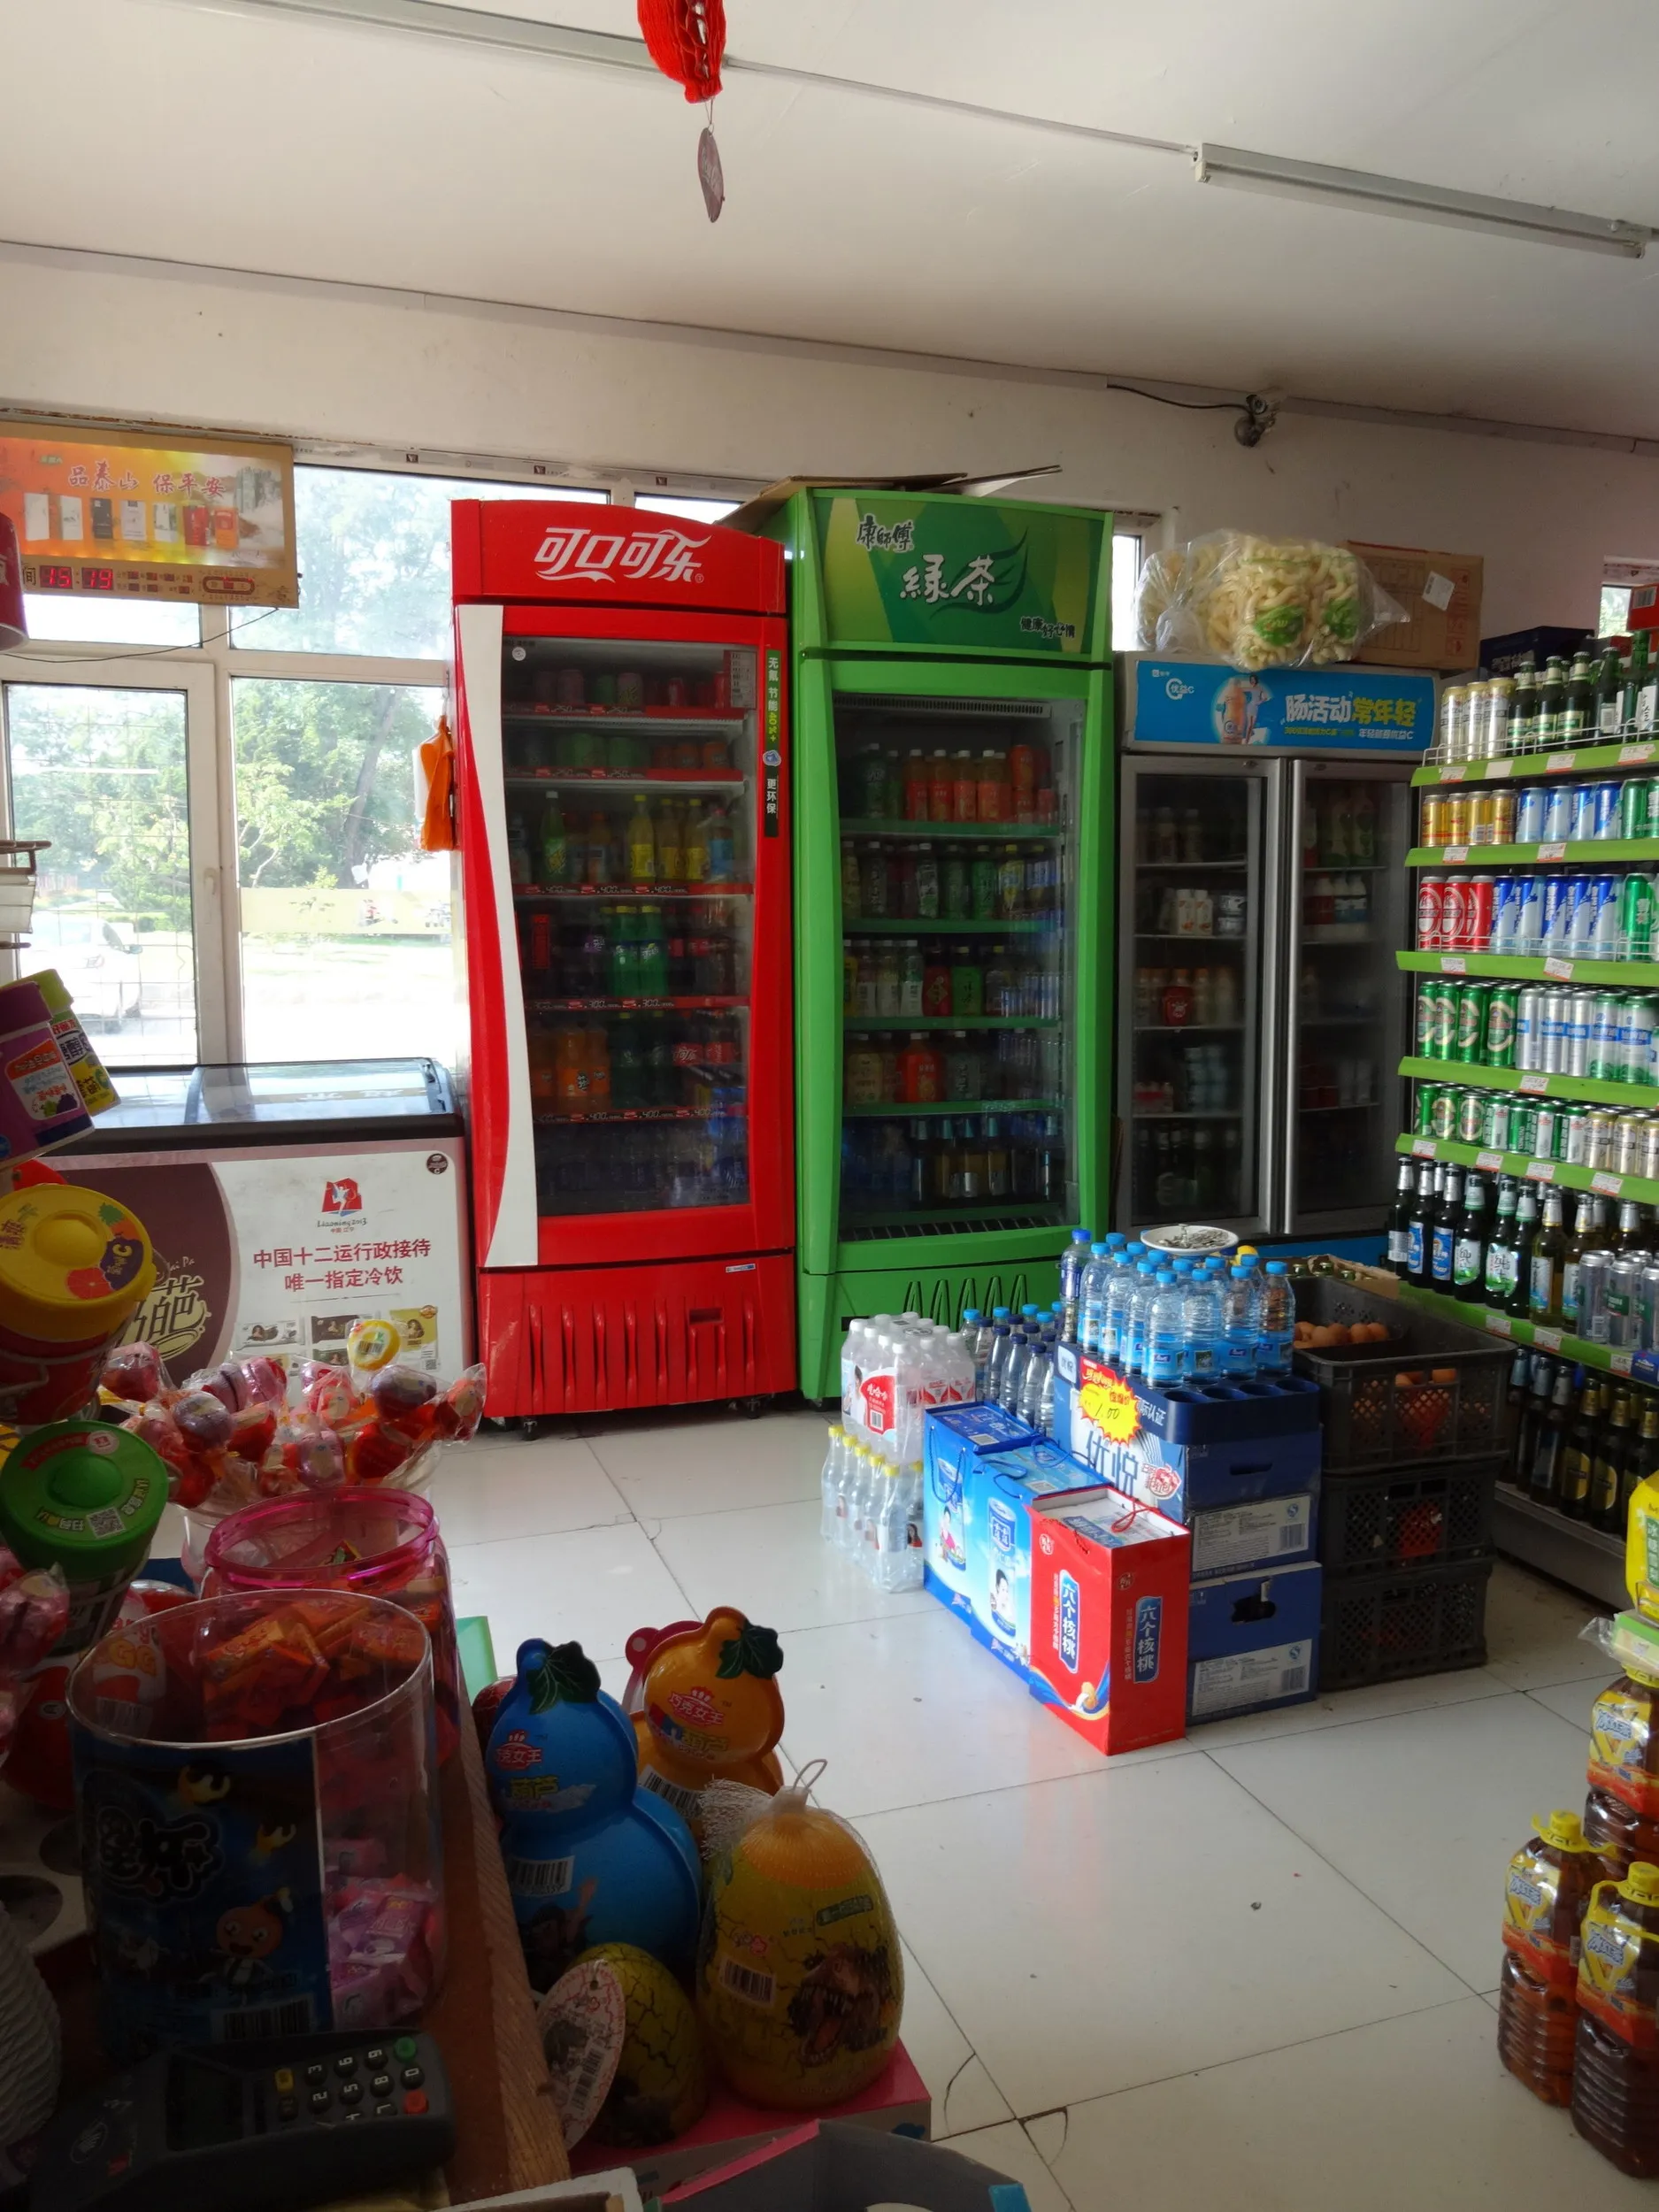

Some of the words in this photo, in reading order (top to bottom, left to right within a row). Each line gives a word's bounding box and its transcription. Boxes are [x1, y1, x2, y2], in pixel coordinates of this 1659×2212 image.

[67, 458, 139, 492] 品泰山
[153, 472, 227, 497] 保平安
[534, 527, 711, 583] 可口可乐
[1020, 616, 1076, 639] 健康好心情
[768, 657, 779, 681] 无氟
[766, 778, 777, 813] 更环保
[253, 1239, 431, 1269] 中国十二运行政接待
[284, 1265, 403, 1292] 唯一指定冷饮
[1095, 1402, 1120, 1420] 1.00
[1087, 1431, 1140, 1497] 优悦
[1063, 1584, 1076, 1660] 六个核桃
[1137, 1606, 1158, 1672] 六个核桃
[668, 1692, 725, 1725] 巧克女王
[681, 1732, 729, 1753] 葫芦
[511, 1776, 559, 1800] 葫芦
